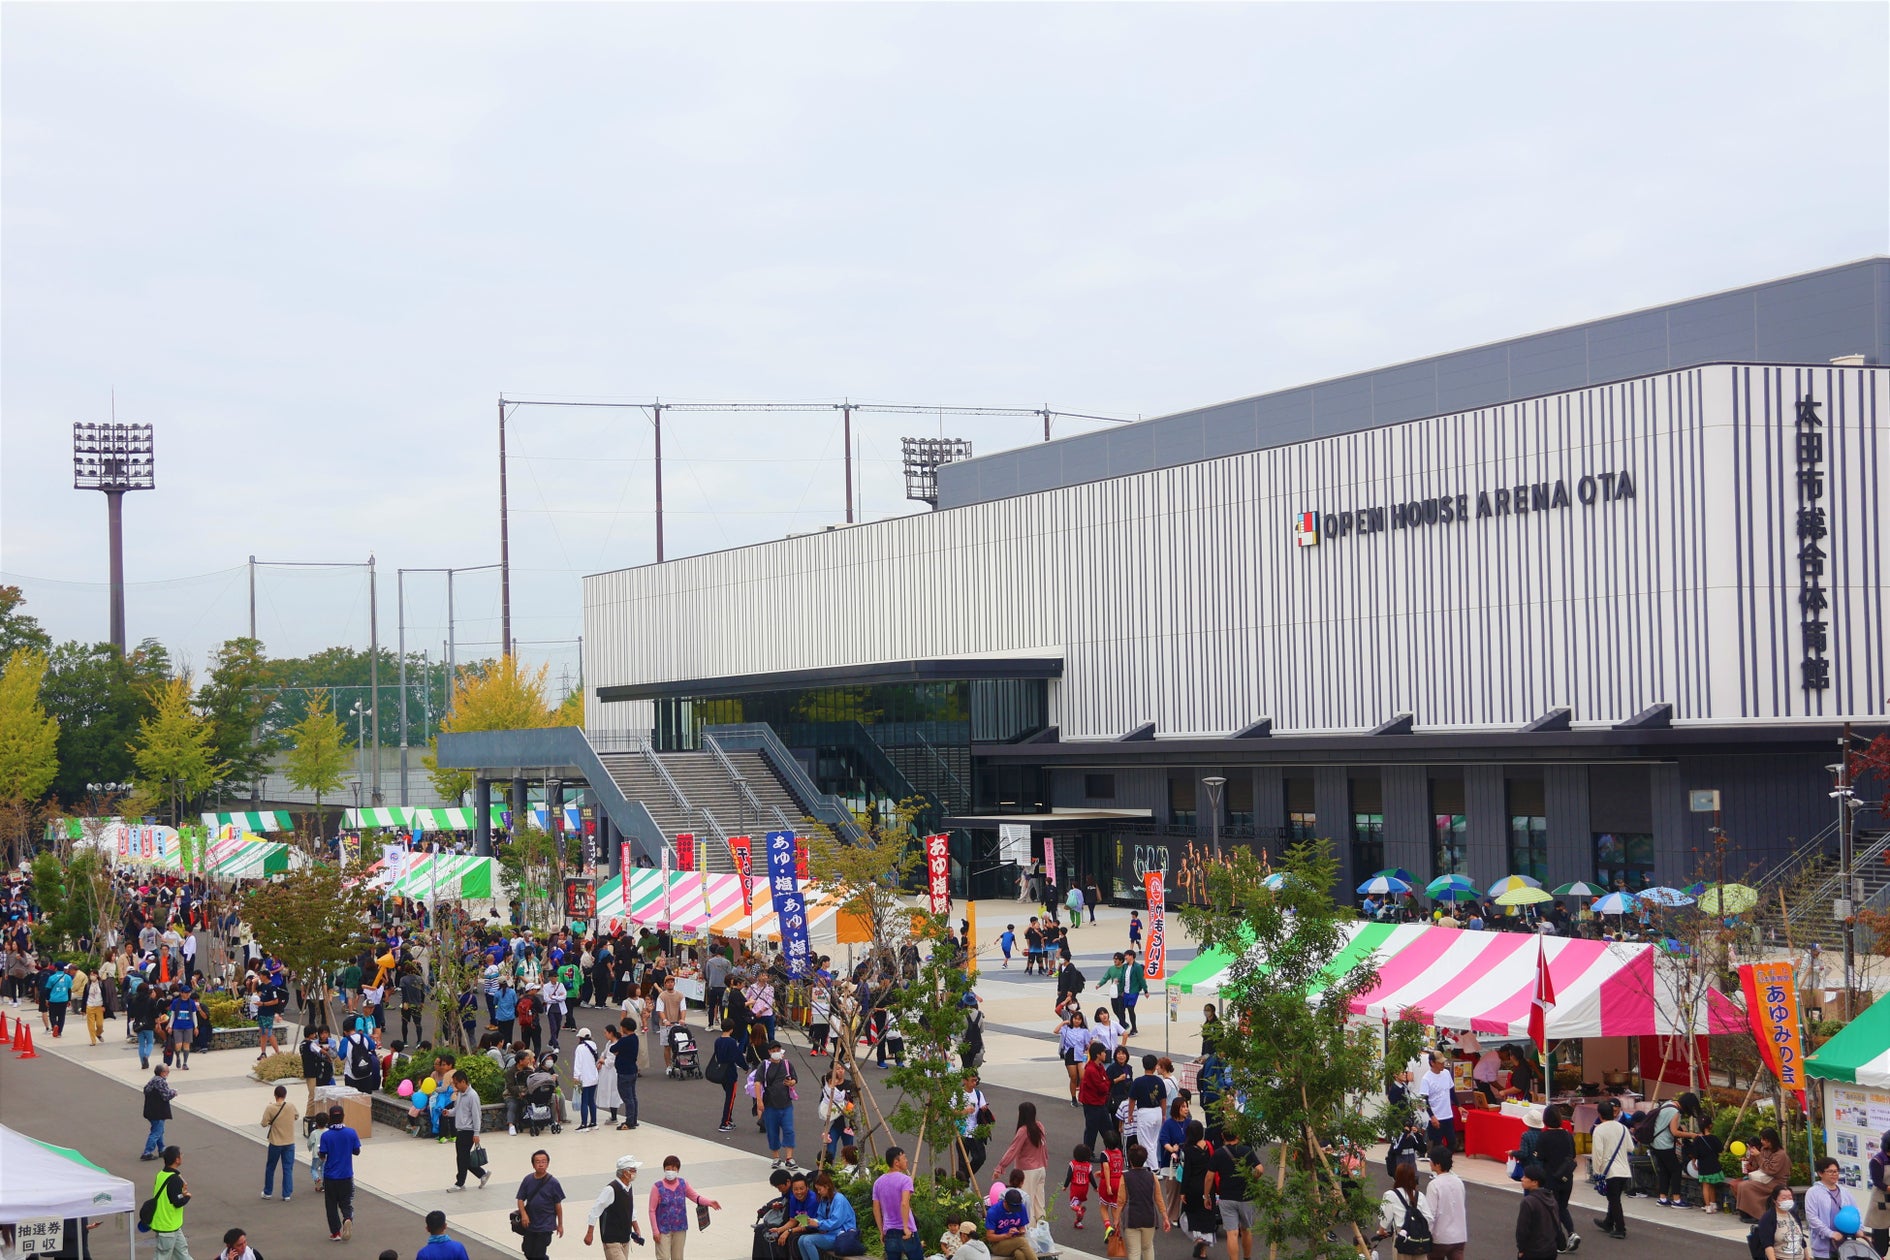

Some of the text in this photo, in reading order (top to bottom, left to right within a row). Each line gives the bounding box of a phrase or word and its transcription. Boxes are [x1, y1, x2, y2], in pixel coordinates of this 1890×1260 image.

[1324, 470, 1635, 539] OPEN HOUSE ARENA OTA
[1795, 394, 1830, 690] 太田市総合体育館
[772, 835, 794, 897] あゆ・塩
[1147, 904, 1163, 976] やまといも
[1766, 985, 1795, 1084] あゆみの会
[18, 1221, 61, 1237] 抽選券
[22, 1238, 56, 1252] 回収
